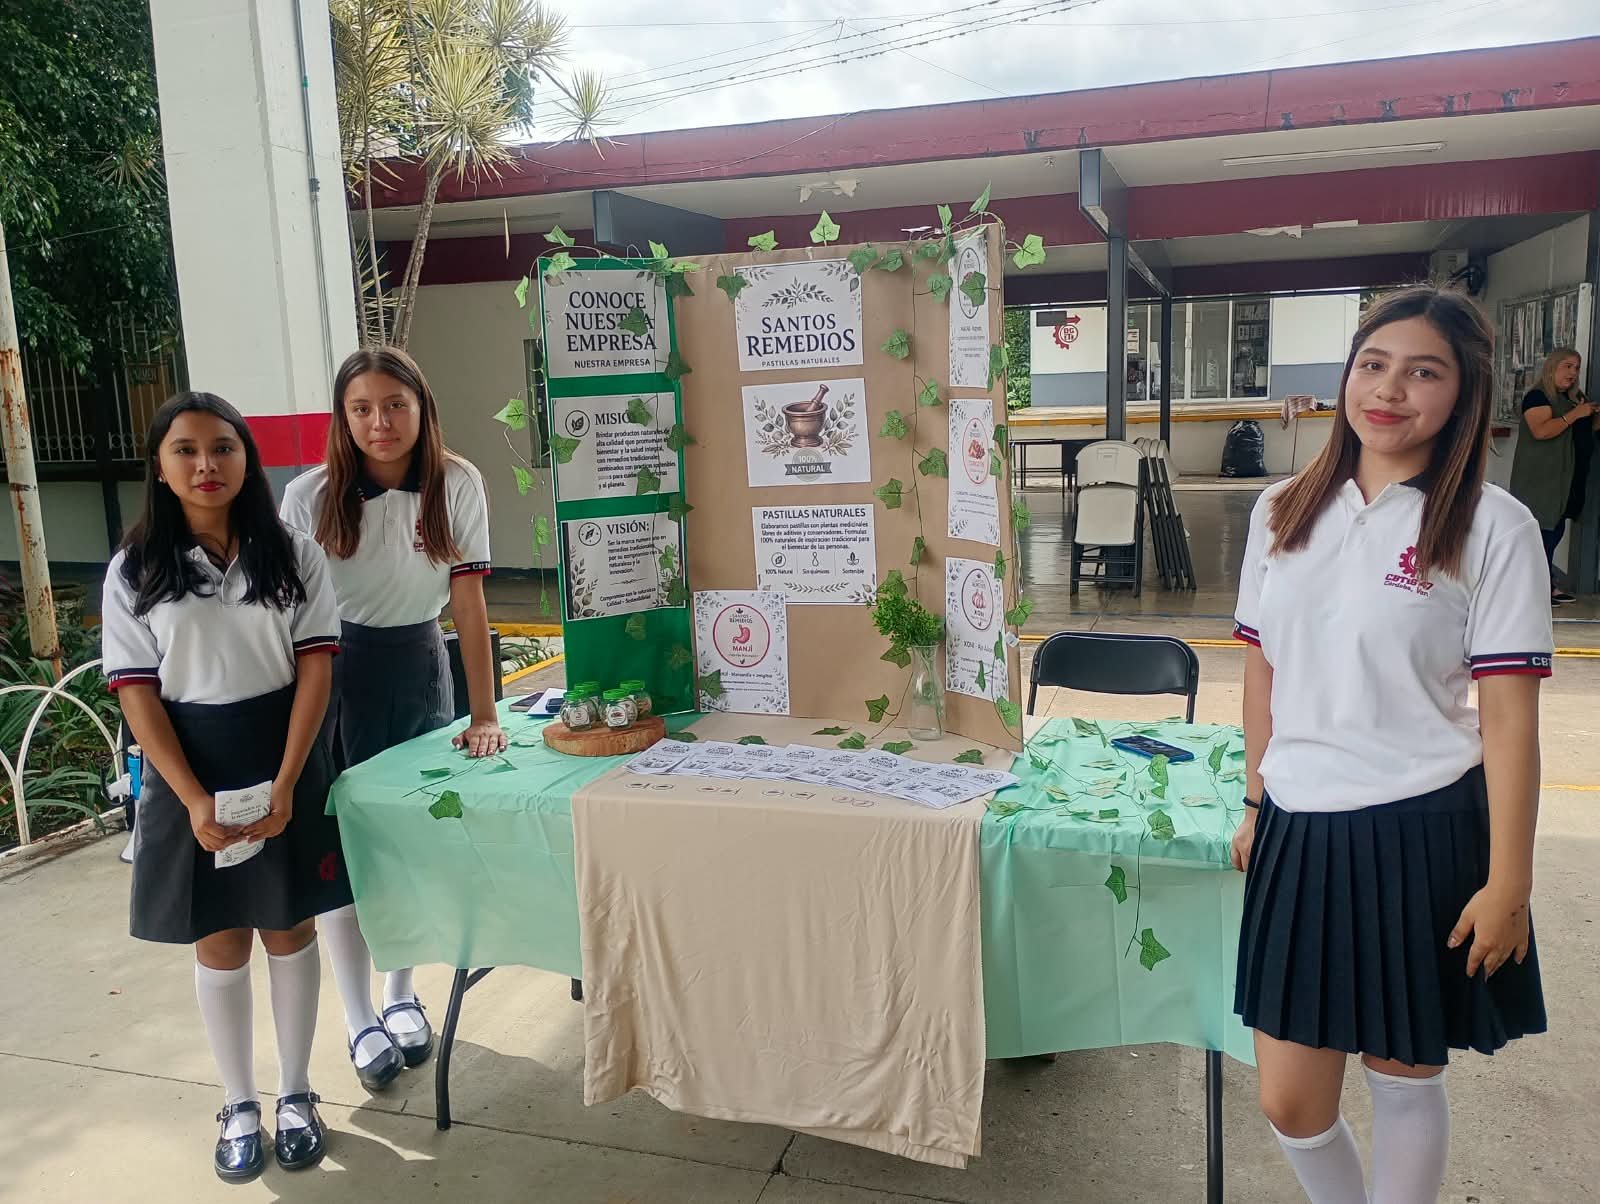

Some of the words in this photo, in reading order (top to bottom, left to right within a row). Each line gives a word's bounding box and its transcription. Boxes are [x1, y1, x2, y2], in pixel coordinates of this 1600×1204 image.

[569, 291, 646, 309] CONOCE
[565, 312, 655, 330] NUESTA
[761, 313, 836, 334] SANTOS
[567, 334, 657, 352] EMPRESA
[746, 328, 856, 357] REMEDIOS
[574, 360, 611, 369] NUESTRA
[613, 358, 651, 368] EMPRESA
[801, 357, 840, 365] NATURALES
[595, 412, 632, 425] MISI
[614, 430, 640, 439] productos
[791, 464, 826, 474] NATURAL
[763, 509, 810, 519] PASTILLAS
[812, 508, 866, 519] NATURALES
[606, 520, 650, 535] VISIÓN:
[789, 521, 810, 529] pastillas
[820, 521, 839, 529] plantas
